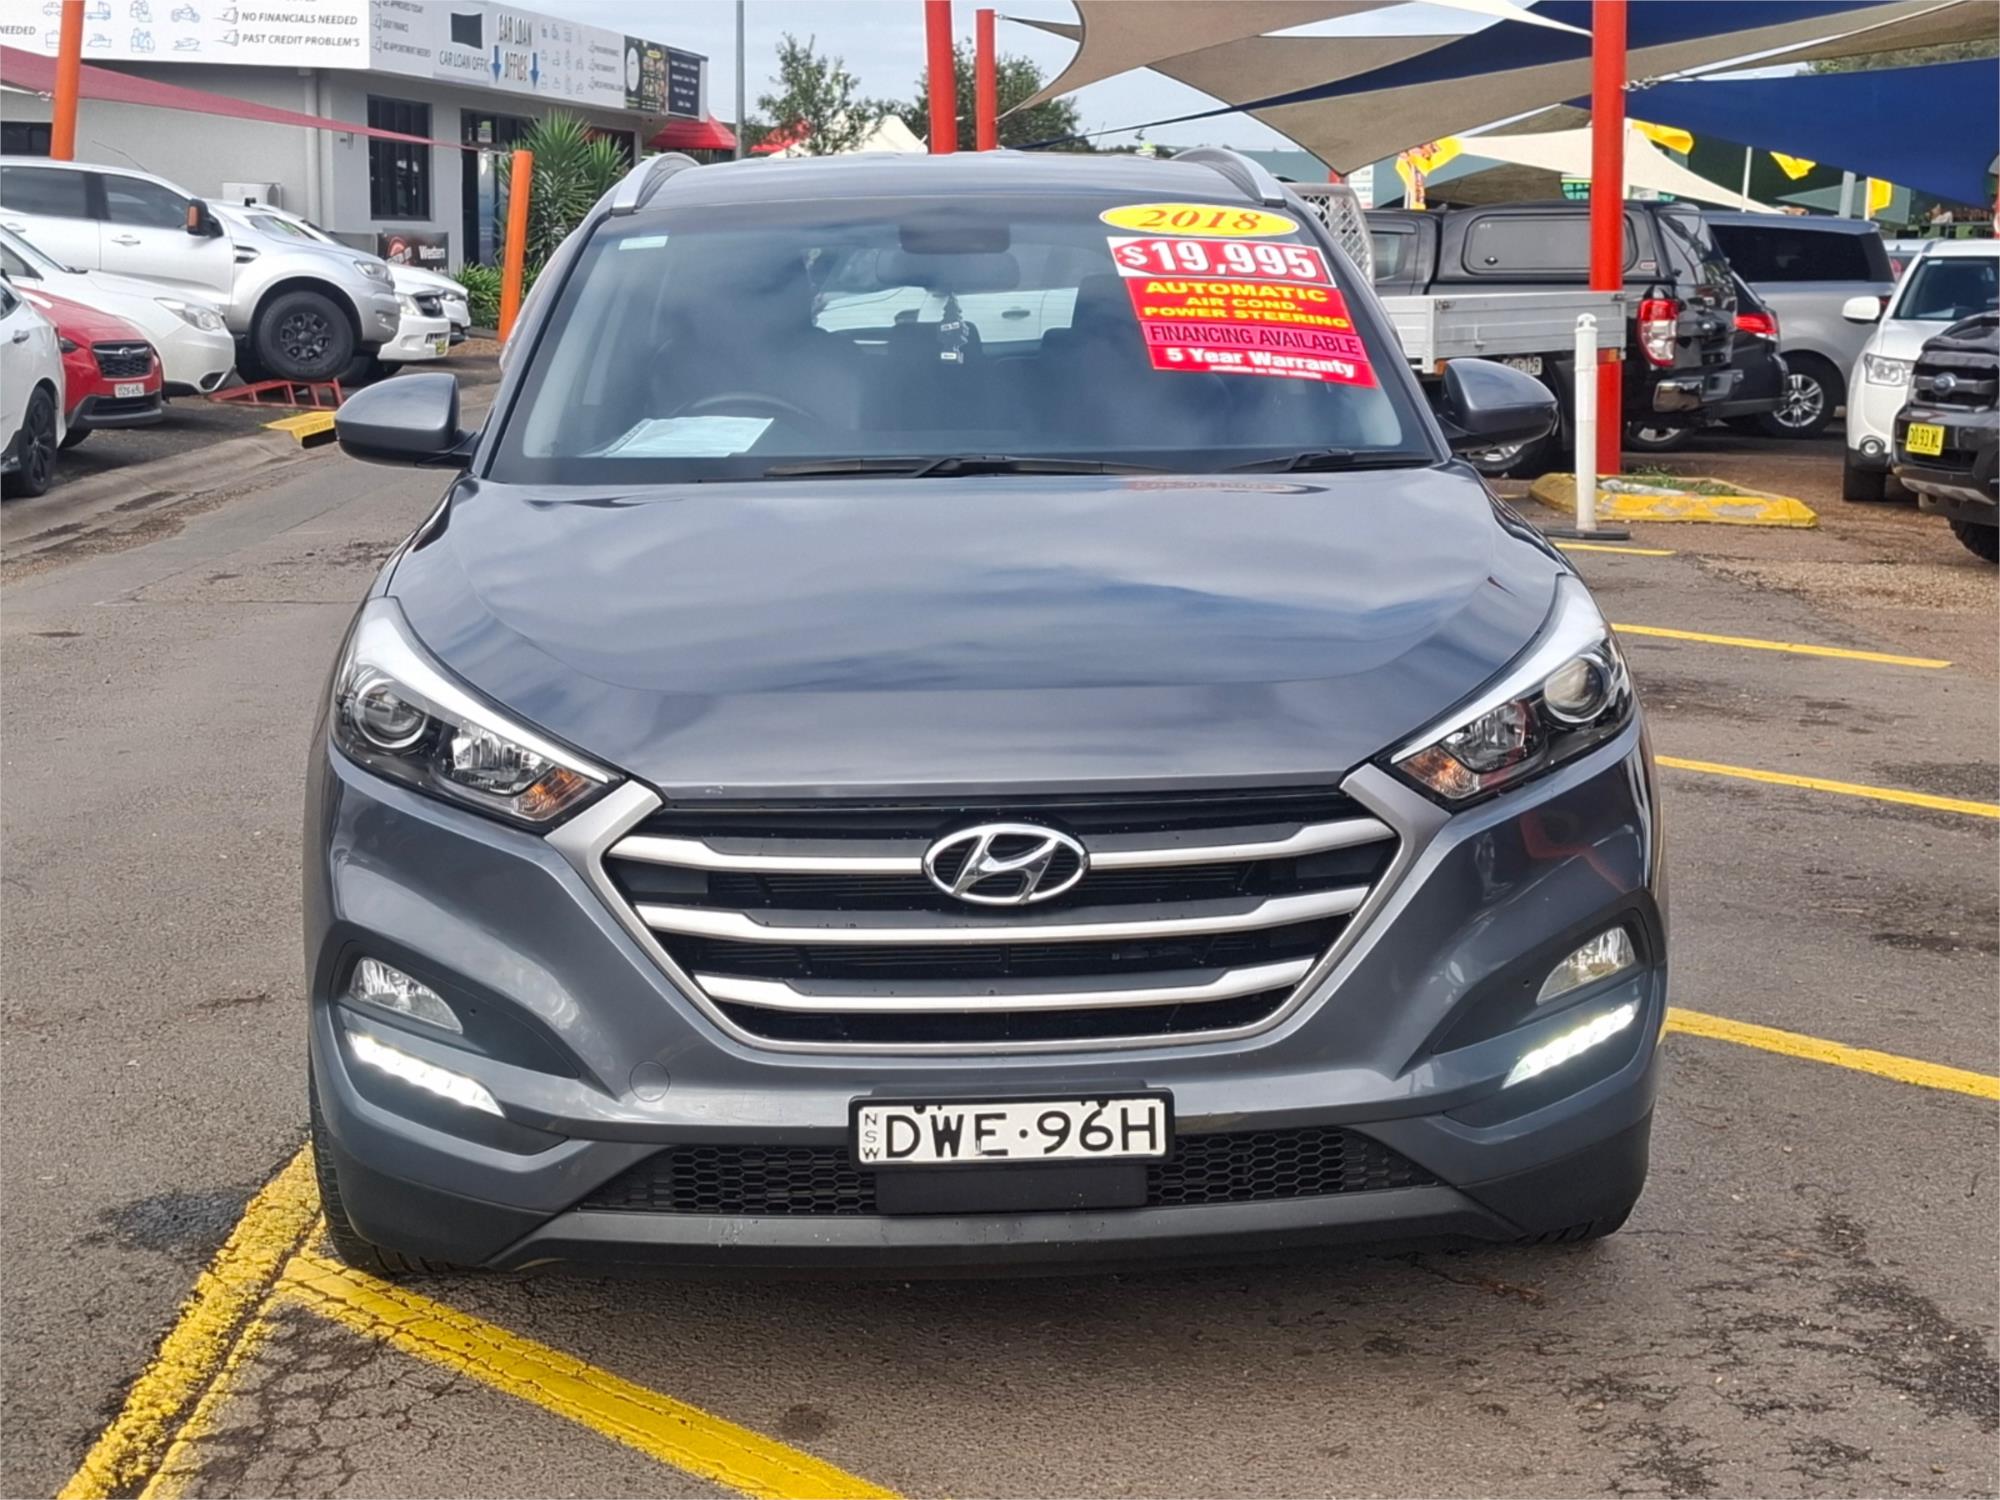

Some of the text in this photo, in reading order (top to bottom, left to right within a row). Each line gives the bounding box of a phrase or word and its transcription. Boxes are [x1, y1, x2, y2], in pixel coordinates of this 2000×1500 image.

[242, 12, 358, 25] NO FINANCIALS NEEDED
[498, 13, 513, 42] CAR
[0, 25, 36, 35] NEEDED
[242, 34, 360, 47] PAST CREDIT PROBLEM'S
[440, 50, 453, 65] CAR
[454, 53, 471, 70] LOAN
[1139, 209, 1261, 231] 2018
[418, 245, 445, 260] Western
[1120, 240, 1318, 278] $19,995
[1146, 281, 1328, 303] AUTOMATIC
[1186, 297, 1304, 311] AIR COND.
[1144, 306, 1349, 328] POWER STEERING
[1150, 325, 1361, 356] FINANCING AVAILABLE
[1166, 347, 1183, 361] 5
[1189, 348, 1243, 364] Year
[1248, 351, 1355, 378] Warranty
[864, 1112, 881, 1161] NSW
